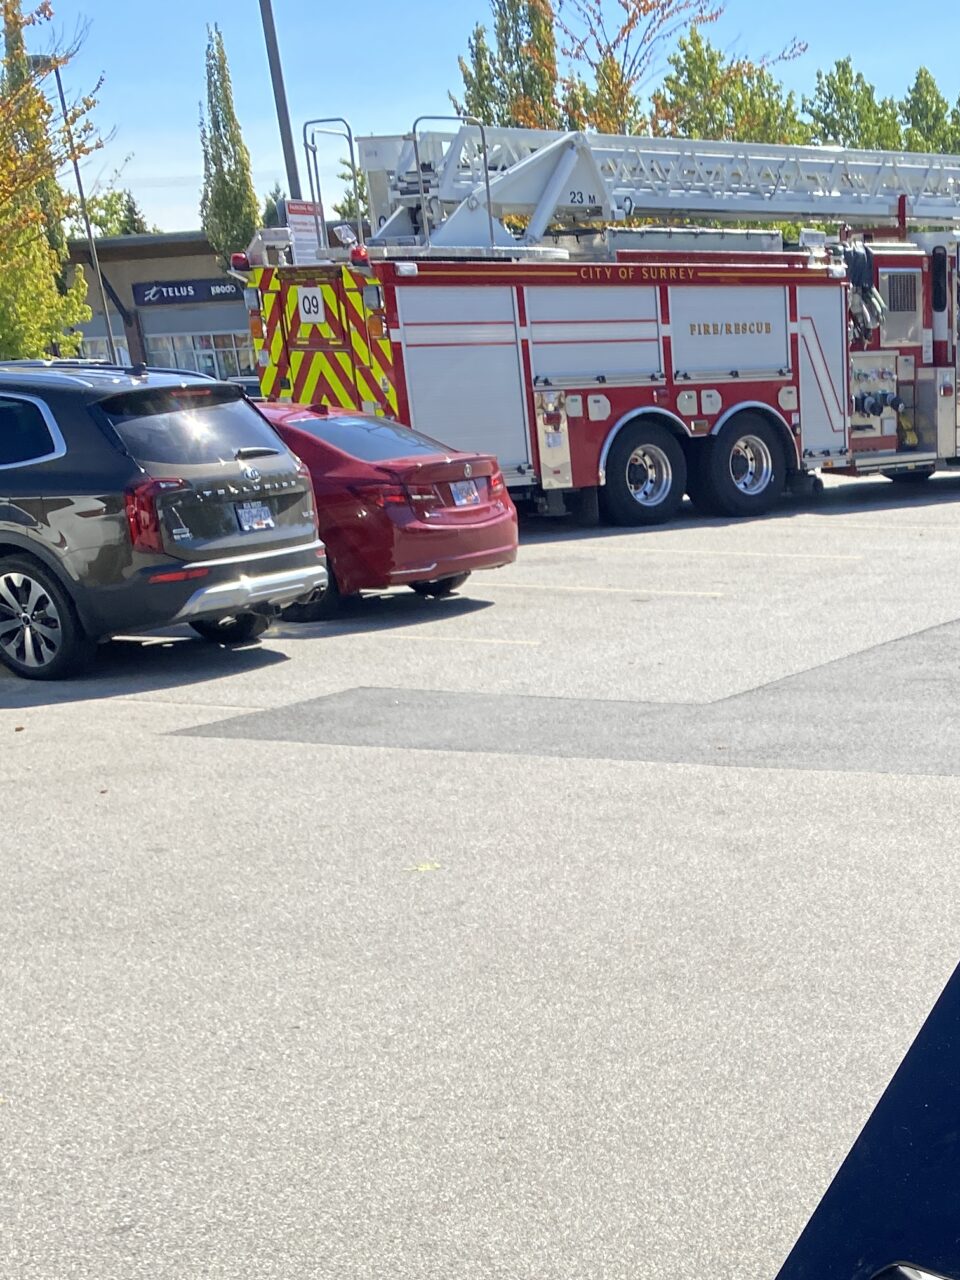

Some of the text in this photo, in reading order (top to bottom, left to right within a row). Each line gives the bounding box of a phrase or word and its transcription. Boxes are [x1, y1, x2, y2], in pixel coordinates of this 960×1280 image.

[569, 191, 596, 205] 23 M
[580, 267, 695, 280] CITY OF SURREY
[162, 285, 195, 297] TELUS
[302, 295, 319, 315] Q9
[690, 322, 772, 336] FIRE/RESCUE
